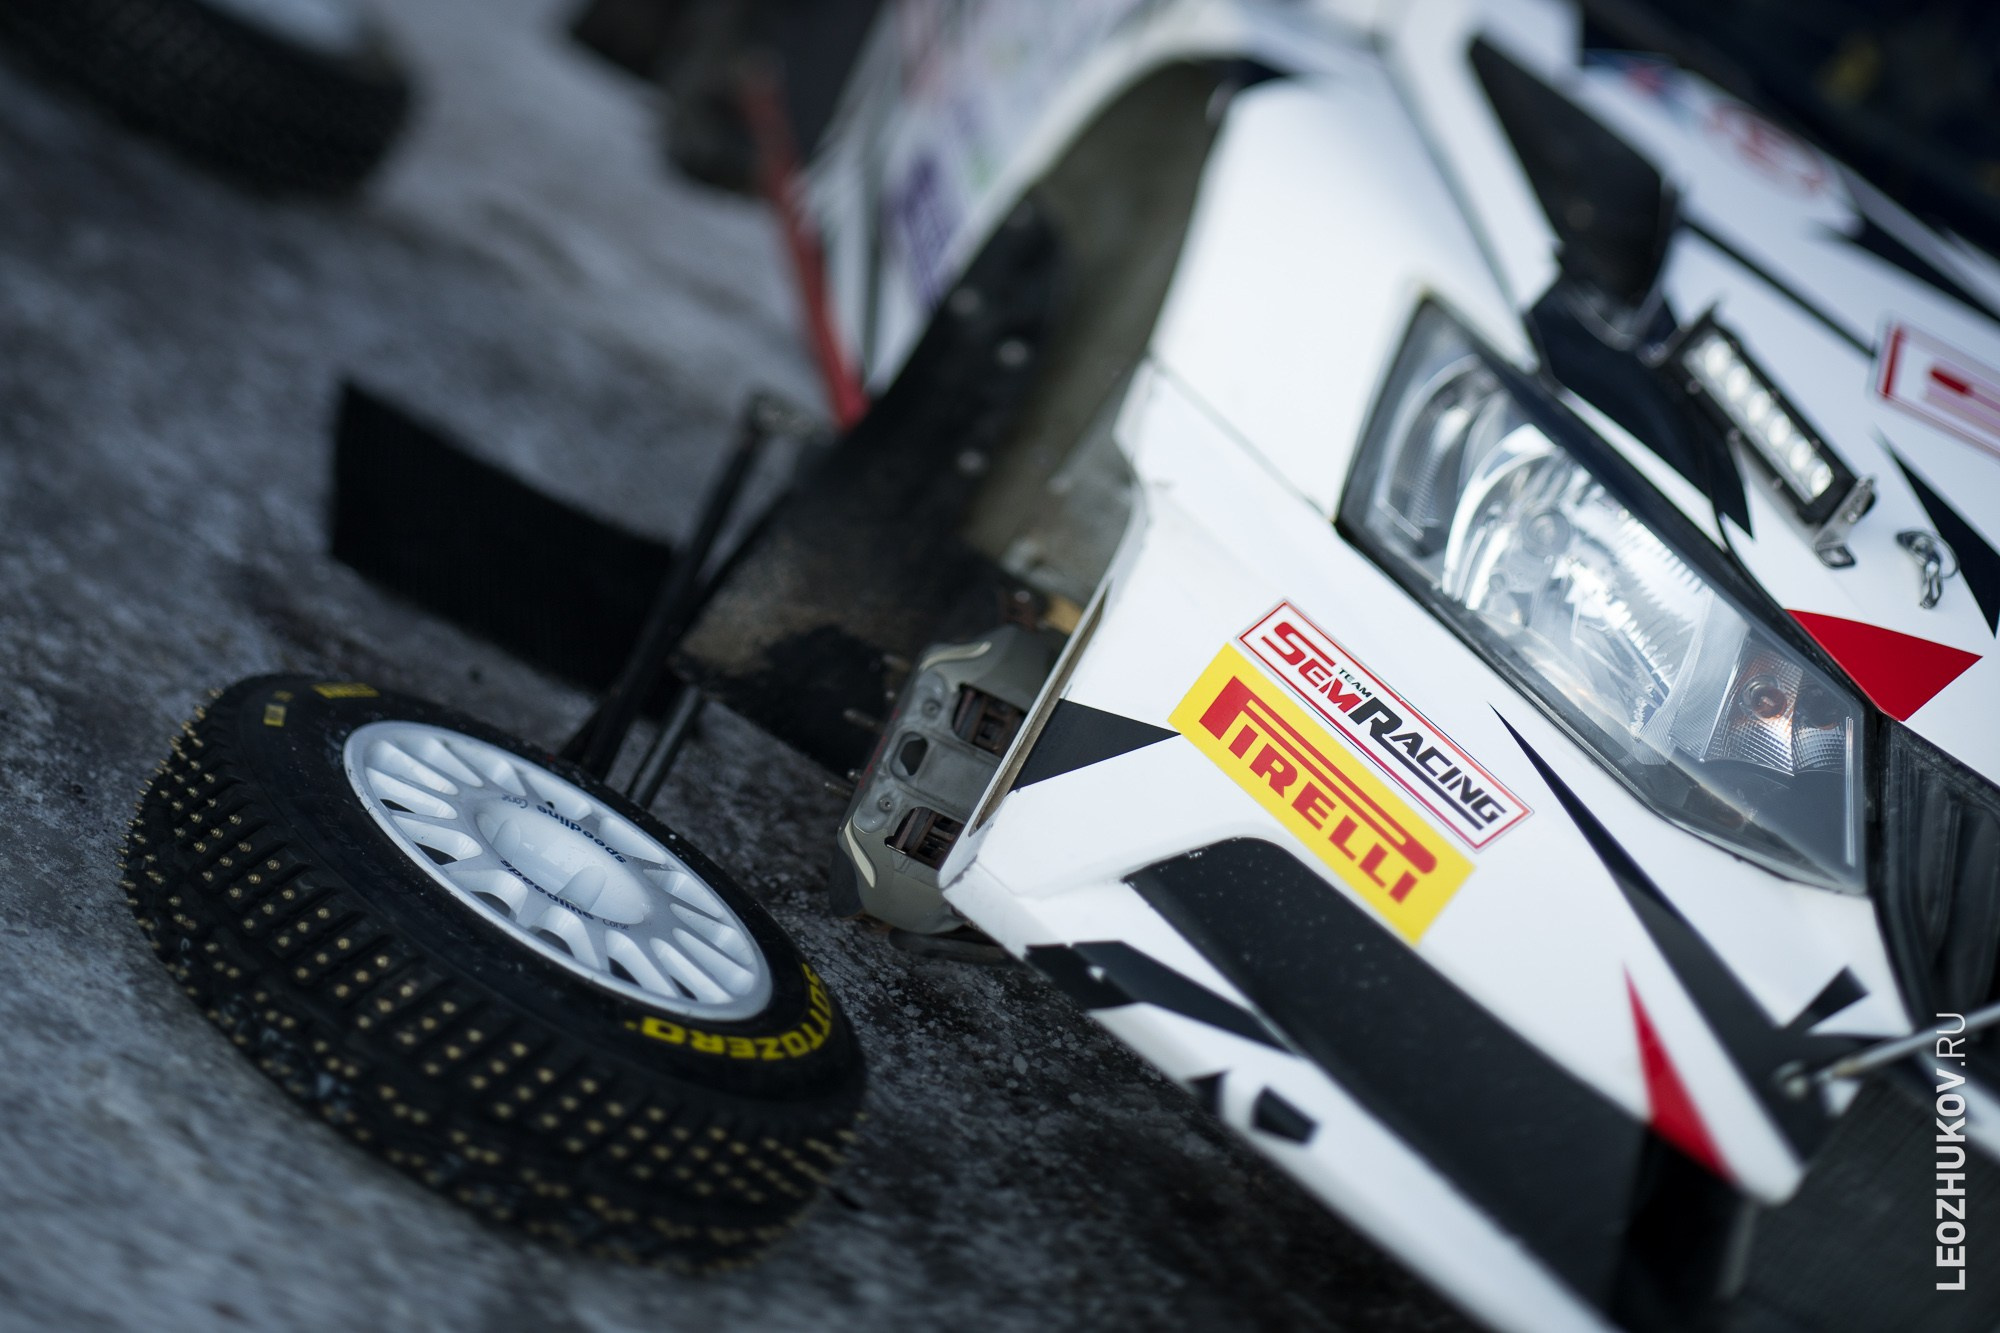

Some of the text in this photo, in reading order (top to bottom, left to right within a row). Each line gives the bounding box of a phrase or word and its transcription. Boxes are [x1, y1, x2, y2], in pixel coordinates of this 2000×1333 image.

[1338, 667, 1373, 698] TEAM
[1198, 675, 1438, 905] PIRELLI
[501, 794, 627, 864] speedline Corse
[500, 858, 631, 931] speedline Corse
